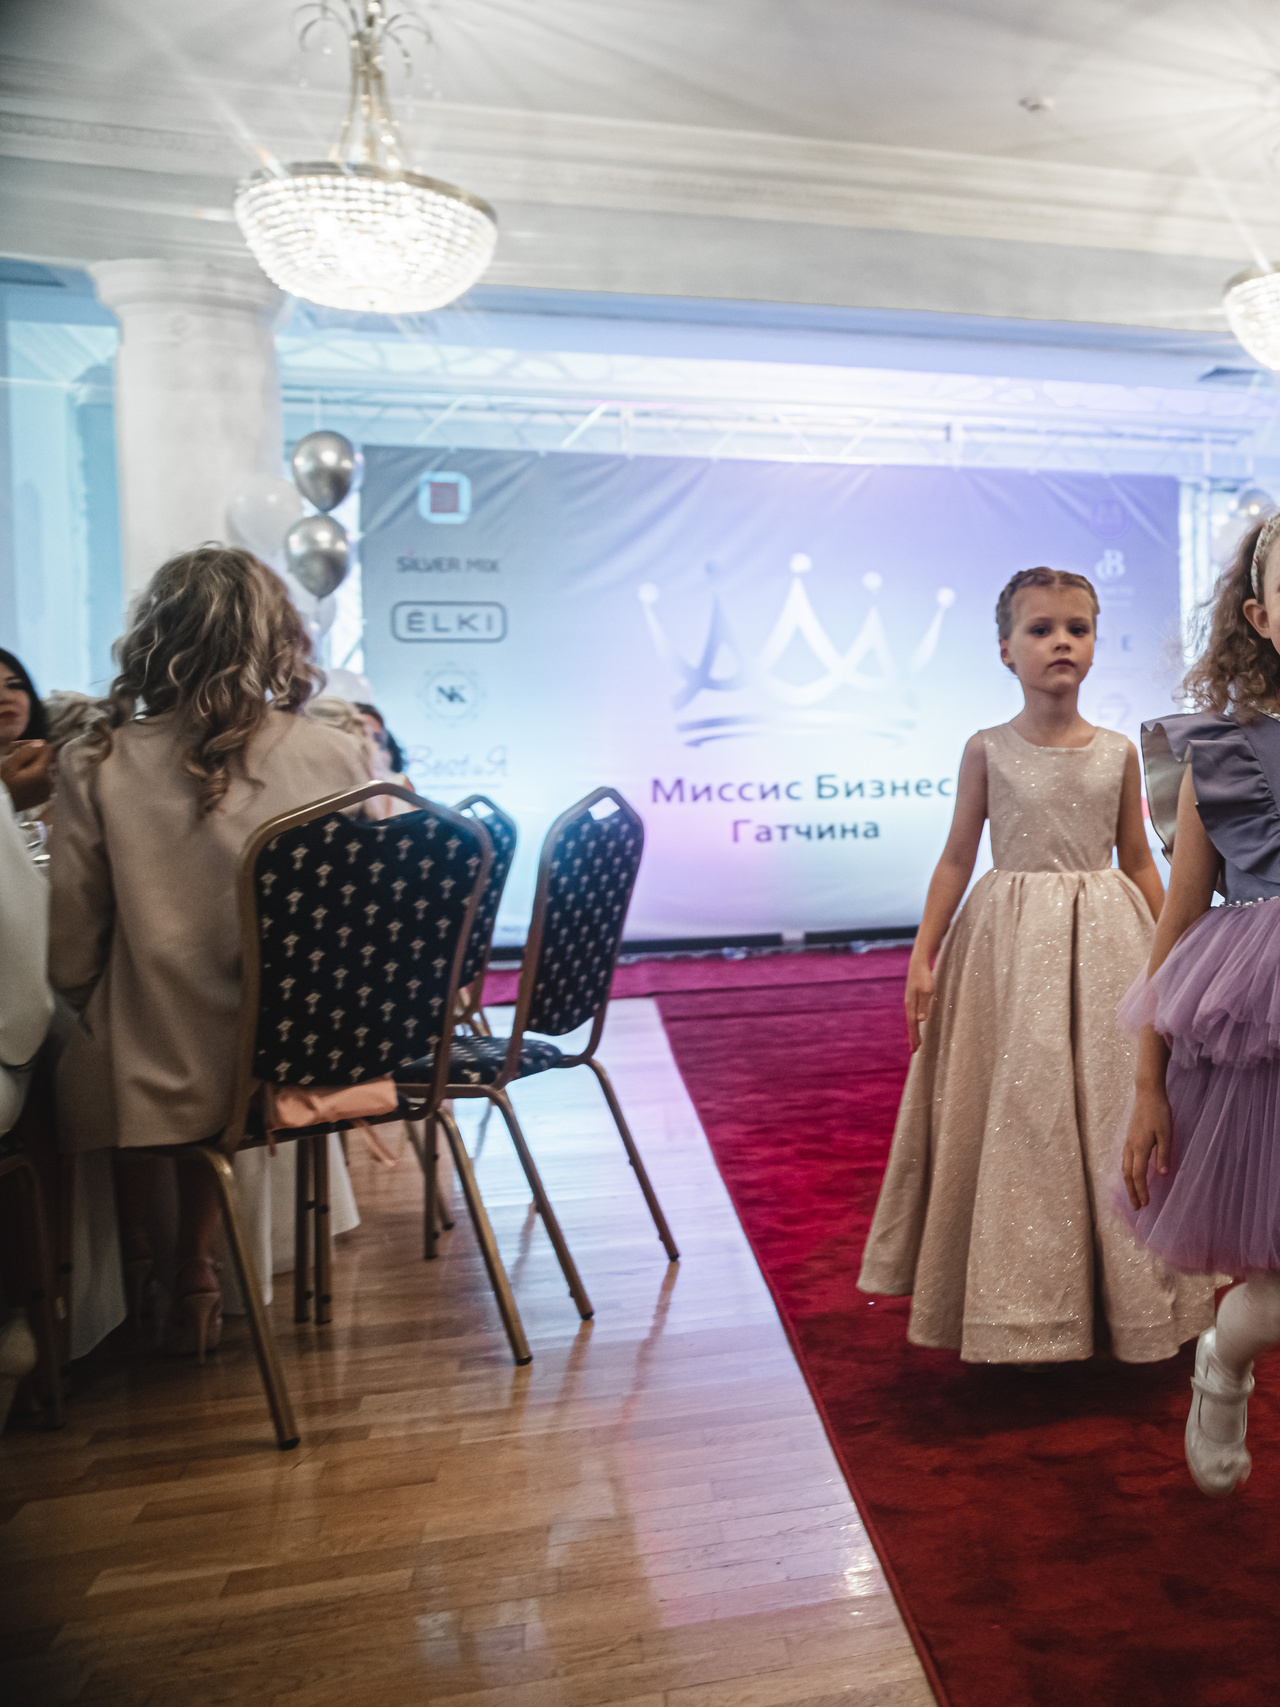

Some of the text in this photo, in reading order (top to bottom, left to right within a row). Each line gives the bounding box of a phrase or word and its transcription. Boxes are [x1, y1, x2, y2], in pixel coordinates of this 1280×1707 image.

[651, 774, 954, 803] Миссис Бизнес
[732, 819, 880, 844] Гатчина
